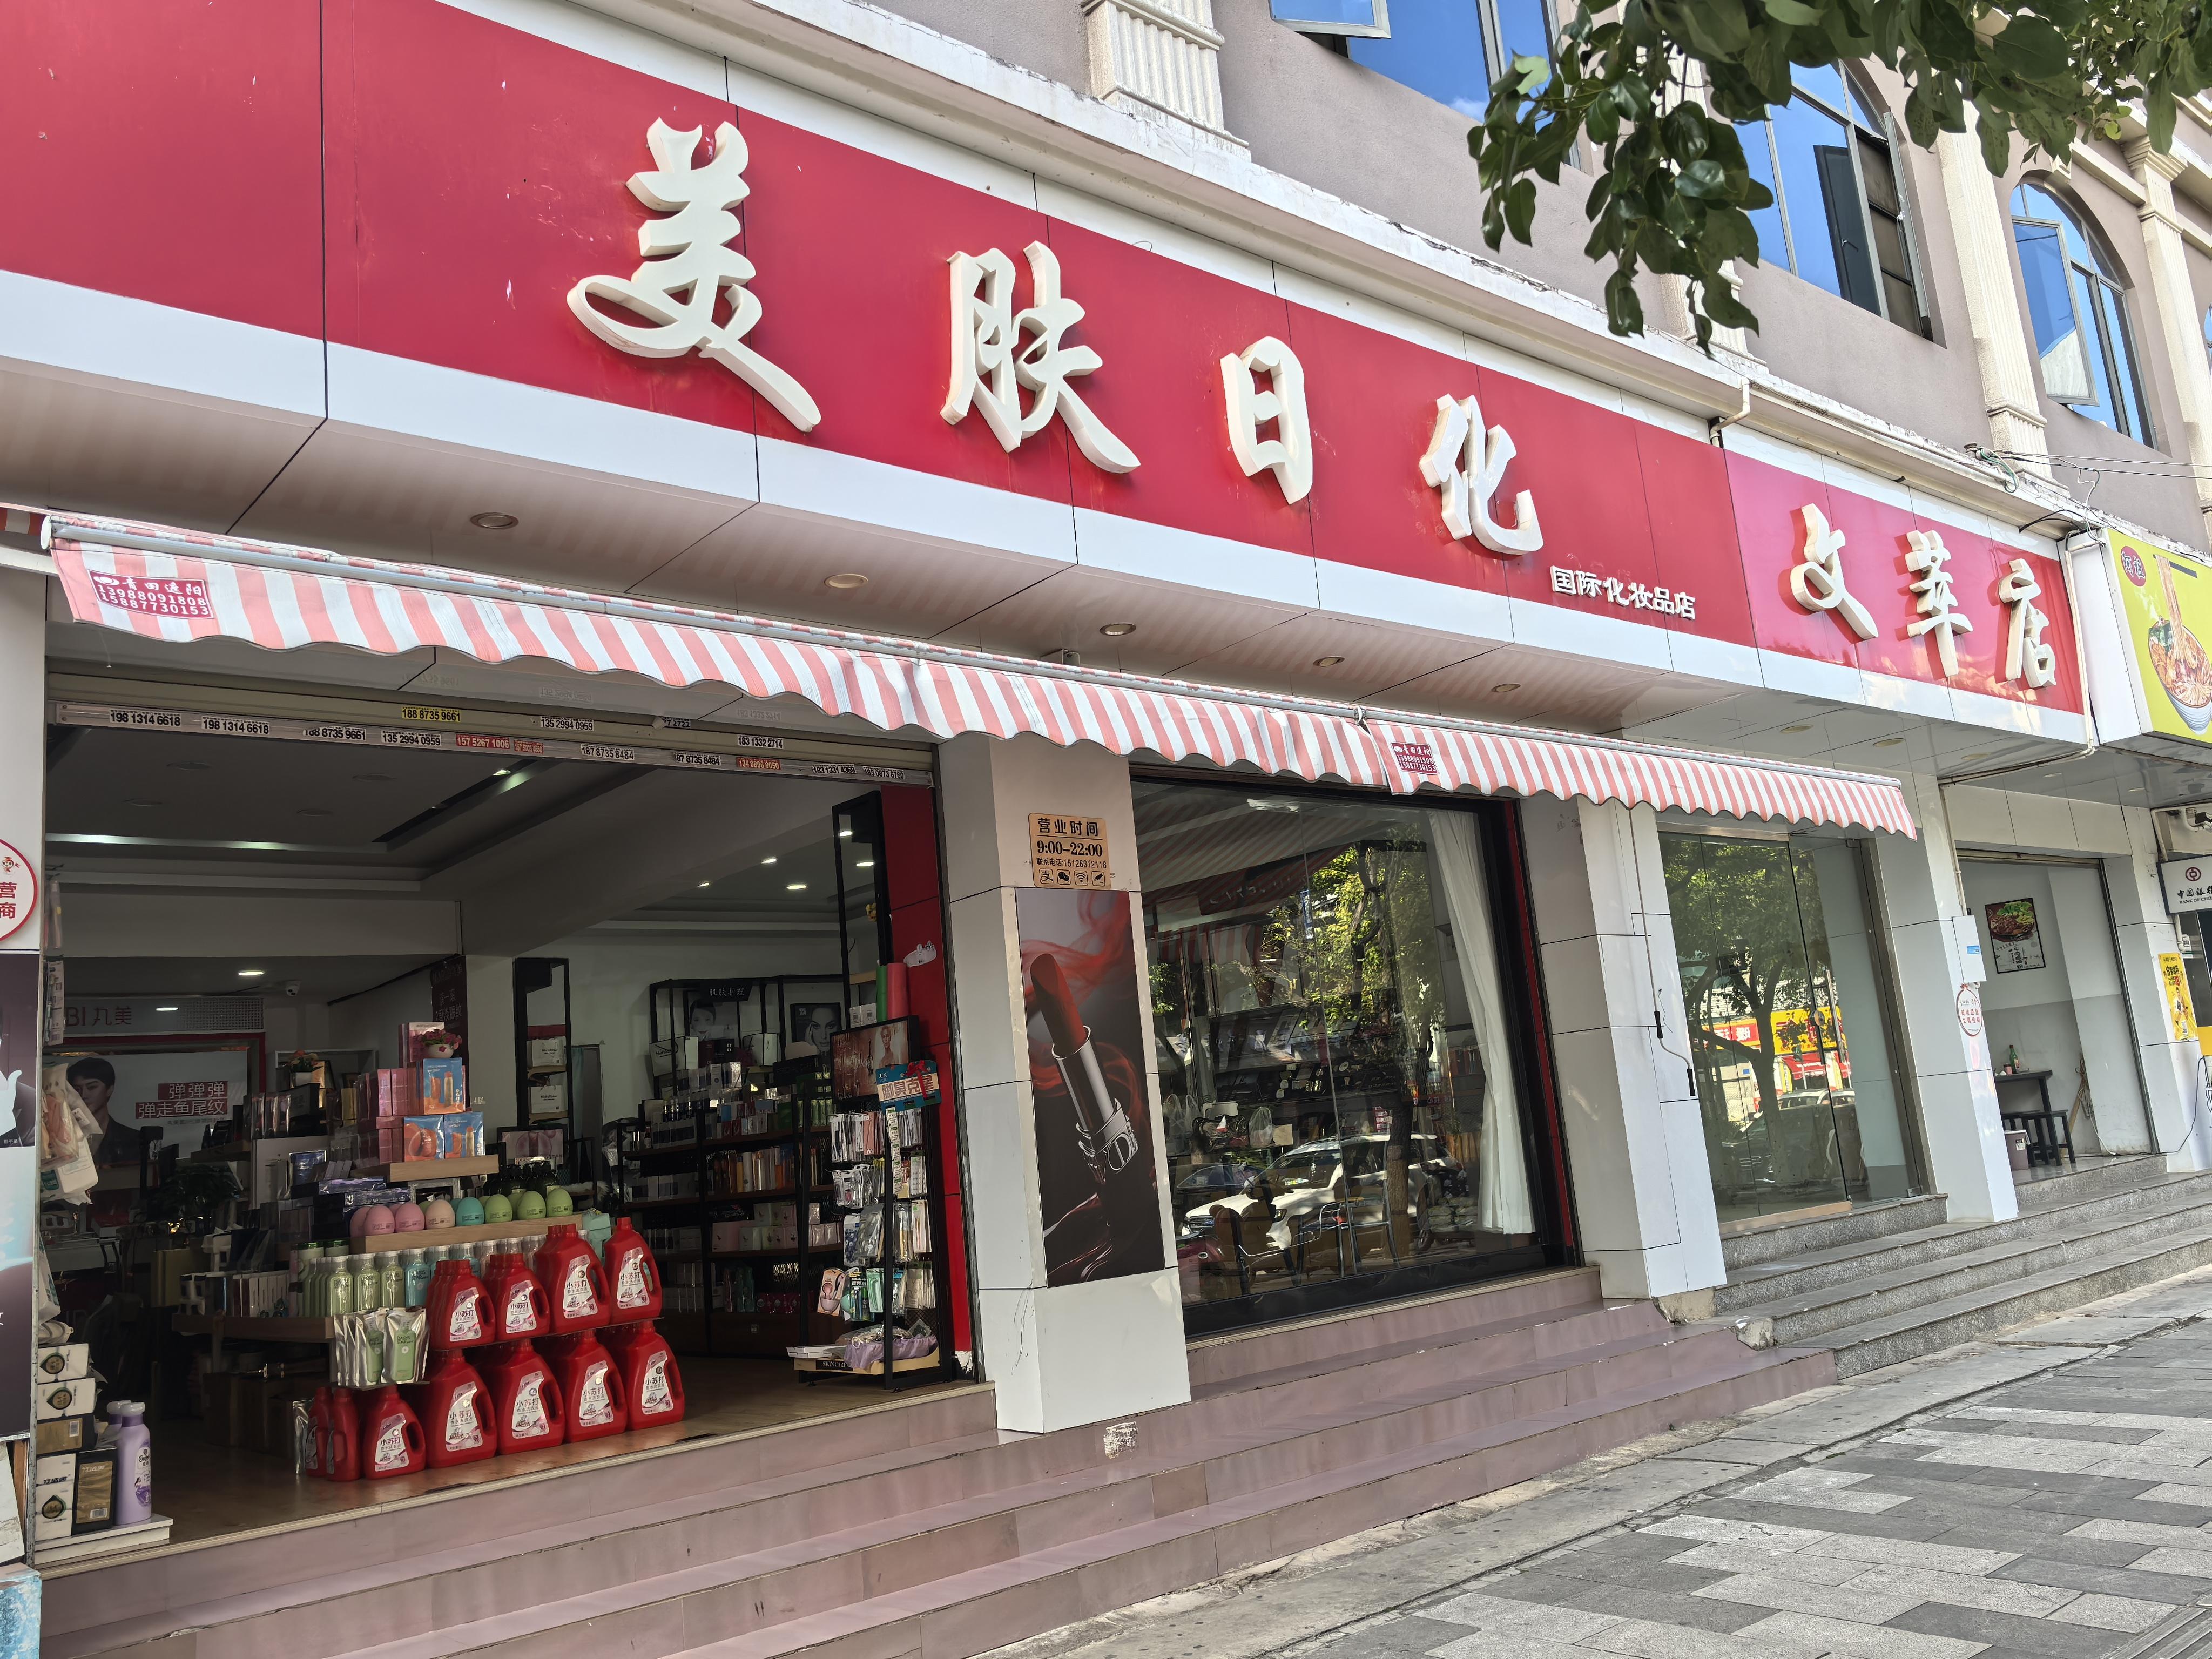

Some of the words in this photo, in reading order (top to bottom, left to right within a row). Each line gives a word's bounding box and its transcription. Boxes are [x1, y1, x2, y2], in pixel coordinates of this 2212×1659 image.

[567, 117, 1543, 556] 美肤日化
[98, 584, 207, 606] 13988091808
[1549, 565, 1696, 621] 国际化妆品店
[101, 591, 209, 615] 15887730153
[111, 712, 129, 723] 198
[131, 713, 154, 724] 1314
[157, 716, 180, 726] 6618
[403, 709, 417, 719] 188
[420, 710, 439, 720] 8735
[441, 711, 460, 721] 9661
[203, 719, 220, 730] 198
[223, 721, 244, 732] 1314
[247, 723, 269, 734] 6618
[541, 719, 554, 727] 135
[556, 719, 574, 729] 2994
[575, 721, 593, 731] 0959
[322, 727, 343, 739] 8735
[345, 729, 366, 740] 9661
[383, 733, 397, 743] 135
[400, 734, 419, 744] 2994
[421, 736, 440, 746] 0959
[457, 738, 469, 746] 157
[738, 737, 750, 745] 183
[751, 738, 766, 747] 1332
[582, 746, 594, 754] 187
[596, 747, 613, 757] 8735
[615, 750, 634, 759] 8484
[1397, 754, 1434, 764] 13988091808
[1400, 761, 1437, 772] 15887730153
[1037, 818, 1098, 837] 营业时间
[1037, 840, 1103, 857] 9:00-22:00
[709, 987, 745, 996] 肌肤护理
[169, 1082, 225, 1099] 弹弹弹
[882, 1075, 934, 1100] 脚臭克星
[138, 1100, 225, 1118] 弹走鱼尾纹
[621, 1272, 640, 1281] 小苏打
[567, 1280, 588, 1290] 小苏打
[456, 1310, 474, 1318] 小苏打
[645, 1377, 664, 1385] 小苏打
[583, 1387, 604, 1396] 小苏打
[516, 1398, 539, 1407] 小苏打
[449, 1410, 471, 1420] 小苏打
[380, 1437, 401, 1446] 小苏打
